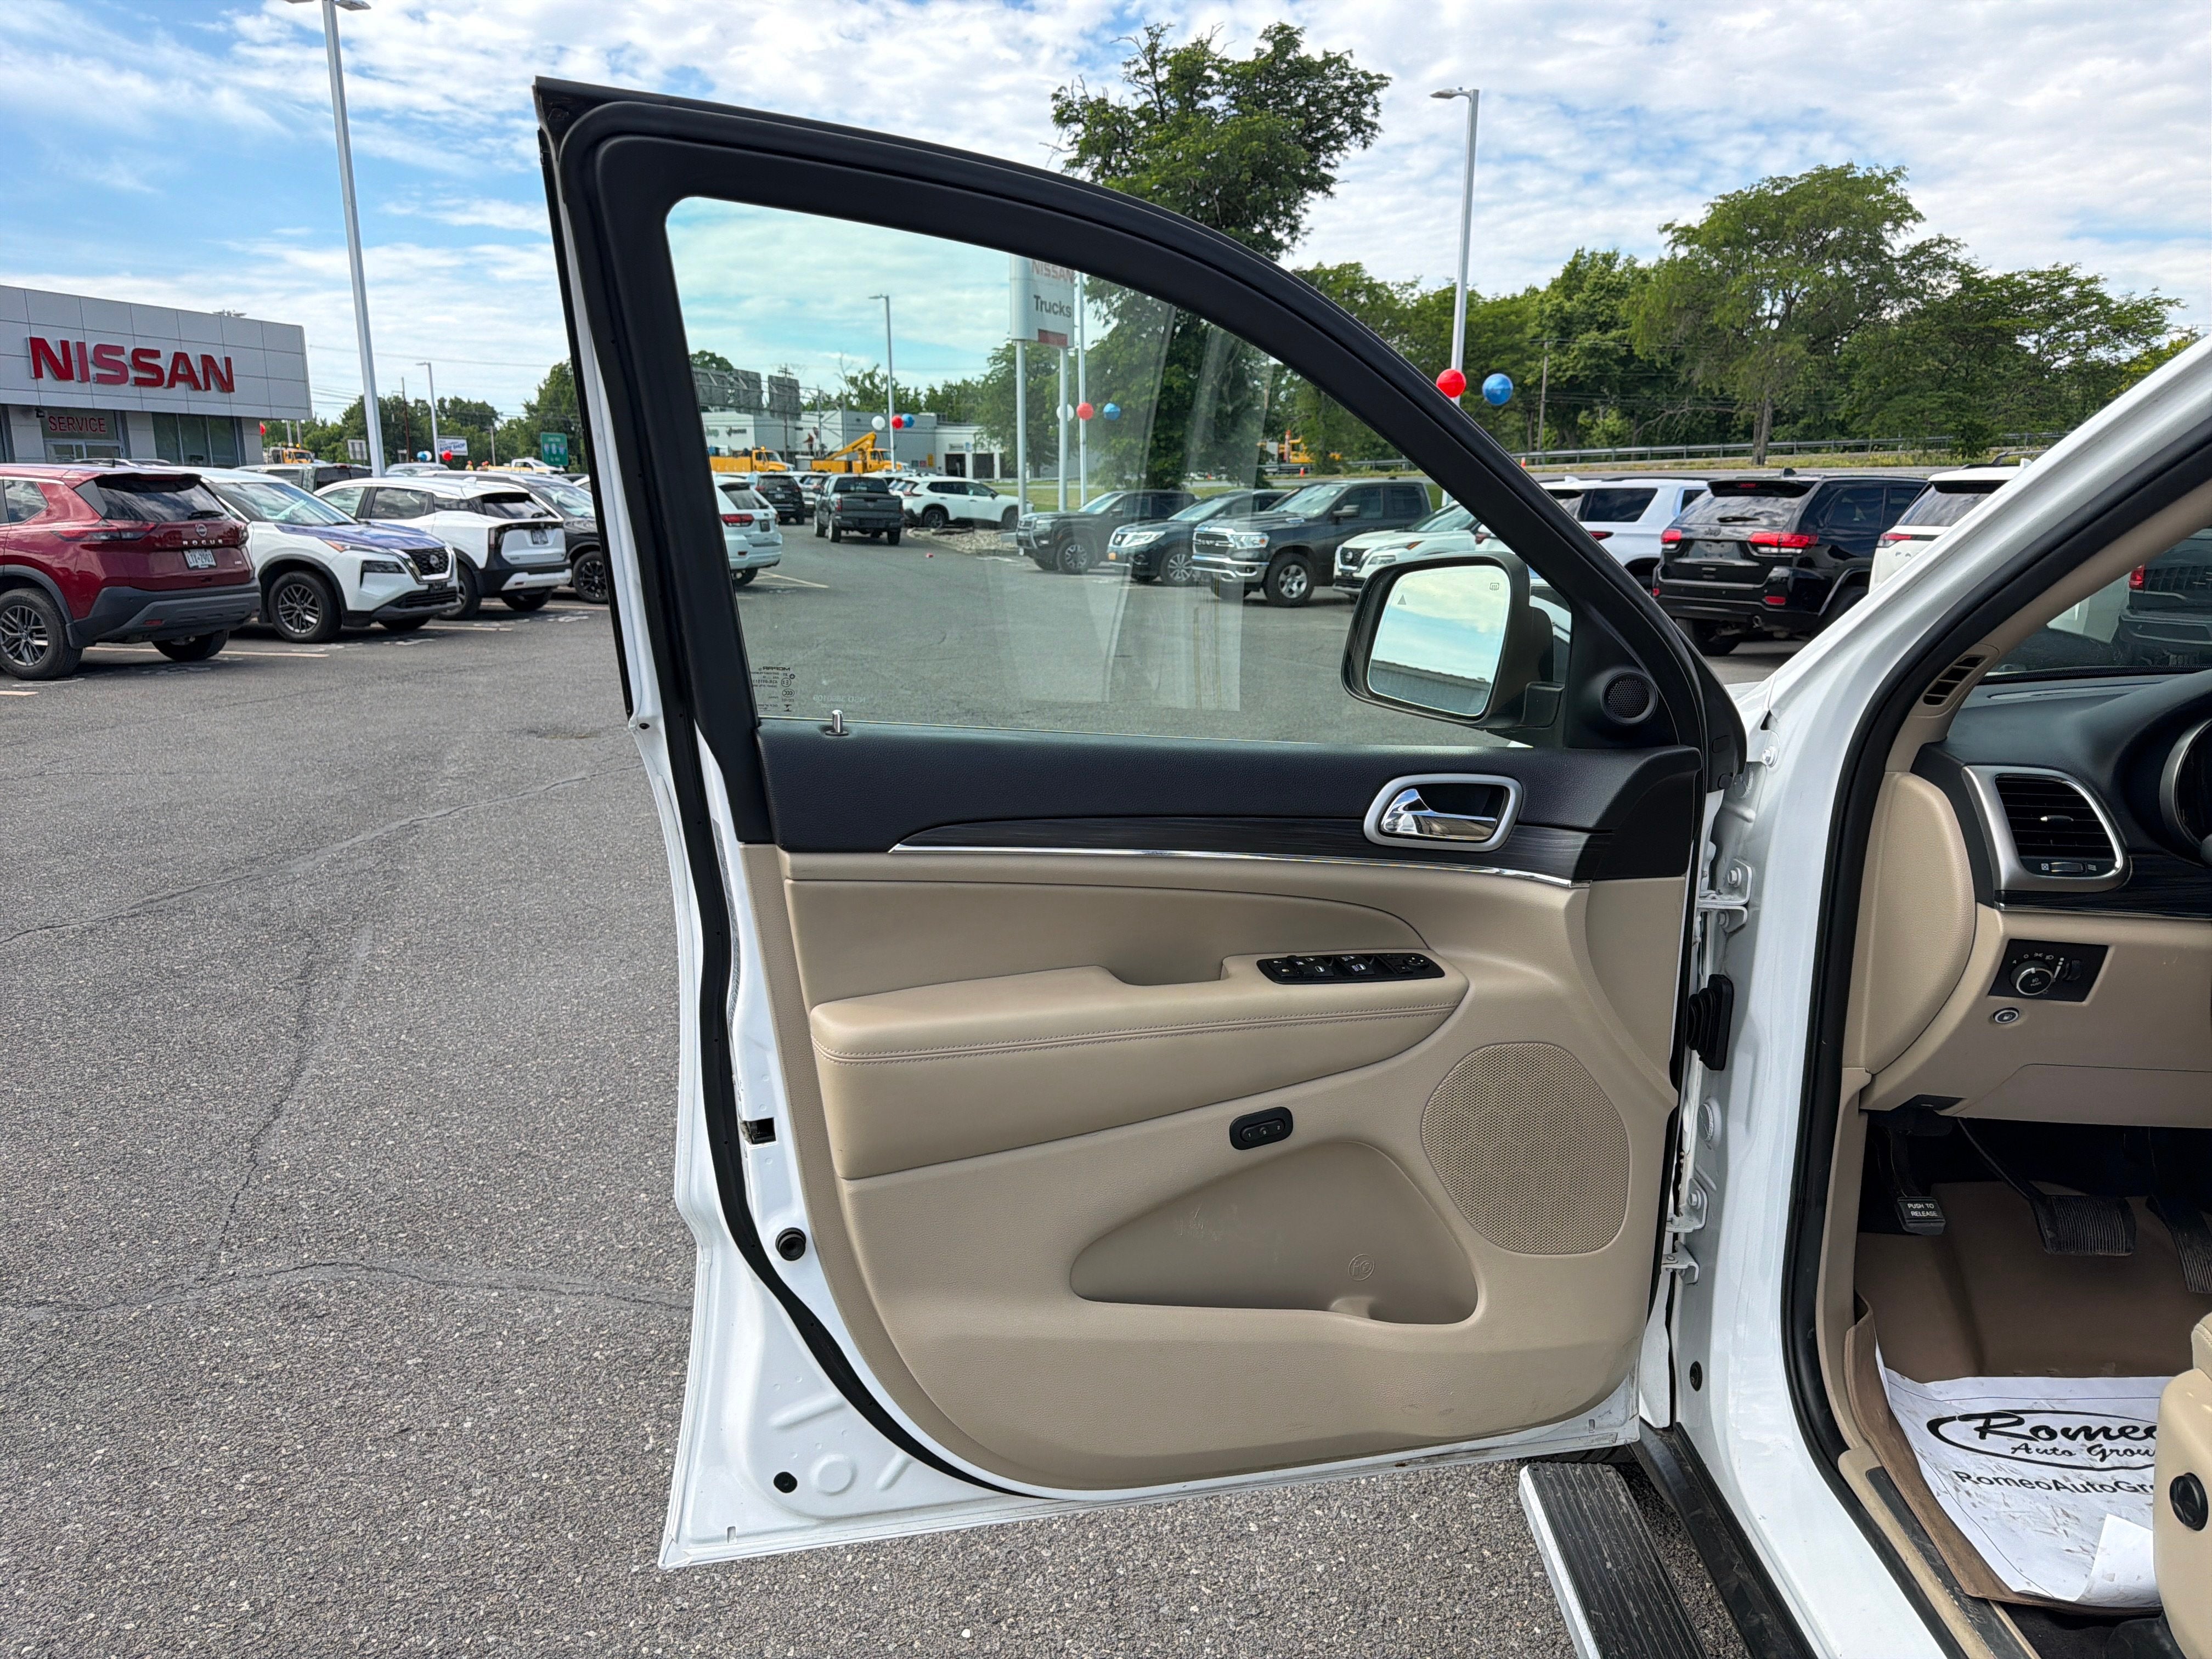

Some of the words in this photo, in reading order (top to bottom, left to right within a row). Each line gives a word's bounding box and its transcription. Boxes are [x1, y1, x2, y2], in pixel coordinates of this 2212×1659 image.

[1032, 259, 1076, 284] NISSAN
[1034, 294, 1073, 318] Trucks
[30, 337, 235, 393] NISSAN
[49, 416, 106, 432] SERVICE
[2011, 1443, 2076, 1457] Auto
[1951, 1470, 2154, 1493] RomeoAutoGr
